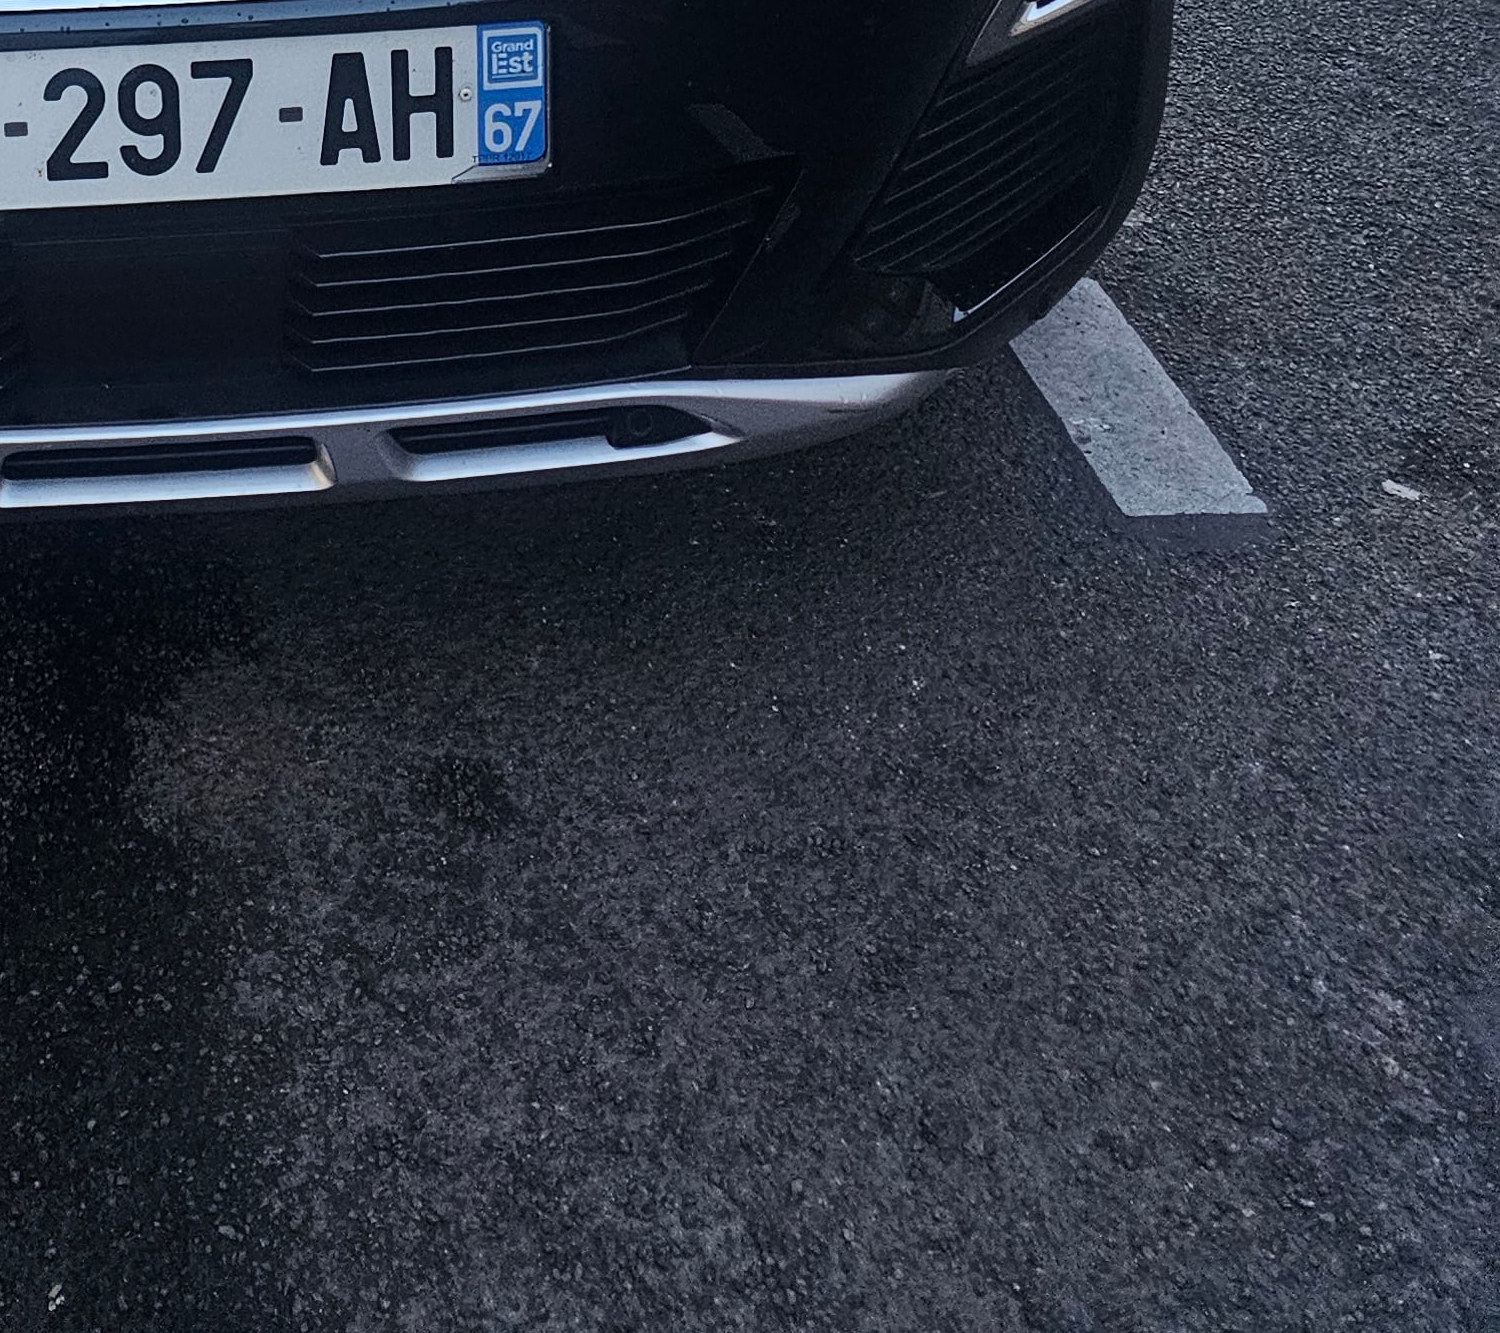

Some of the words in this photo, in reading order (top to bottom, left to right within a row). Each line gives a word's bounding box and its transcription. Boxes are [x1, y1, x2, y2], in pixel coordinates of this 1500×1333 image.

[491, 39, 534, 53] Grand
[491, 51, 534, 75] Est
[484, 100, 542, 153] 67
